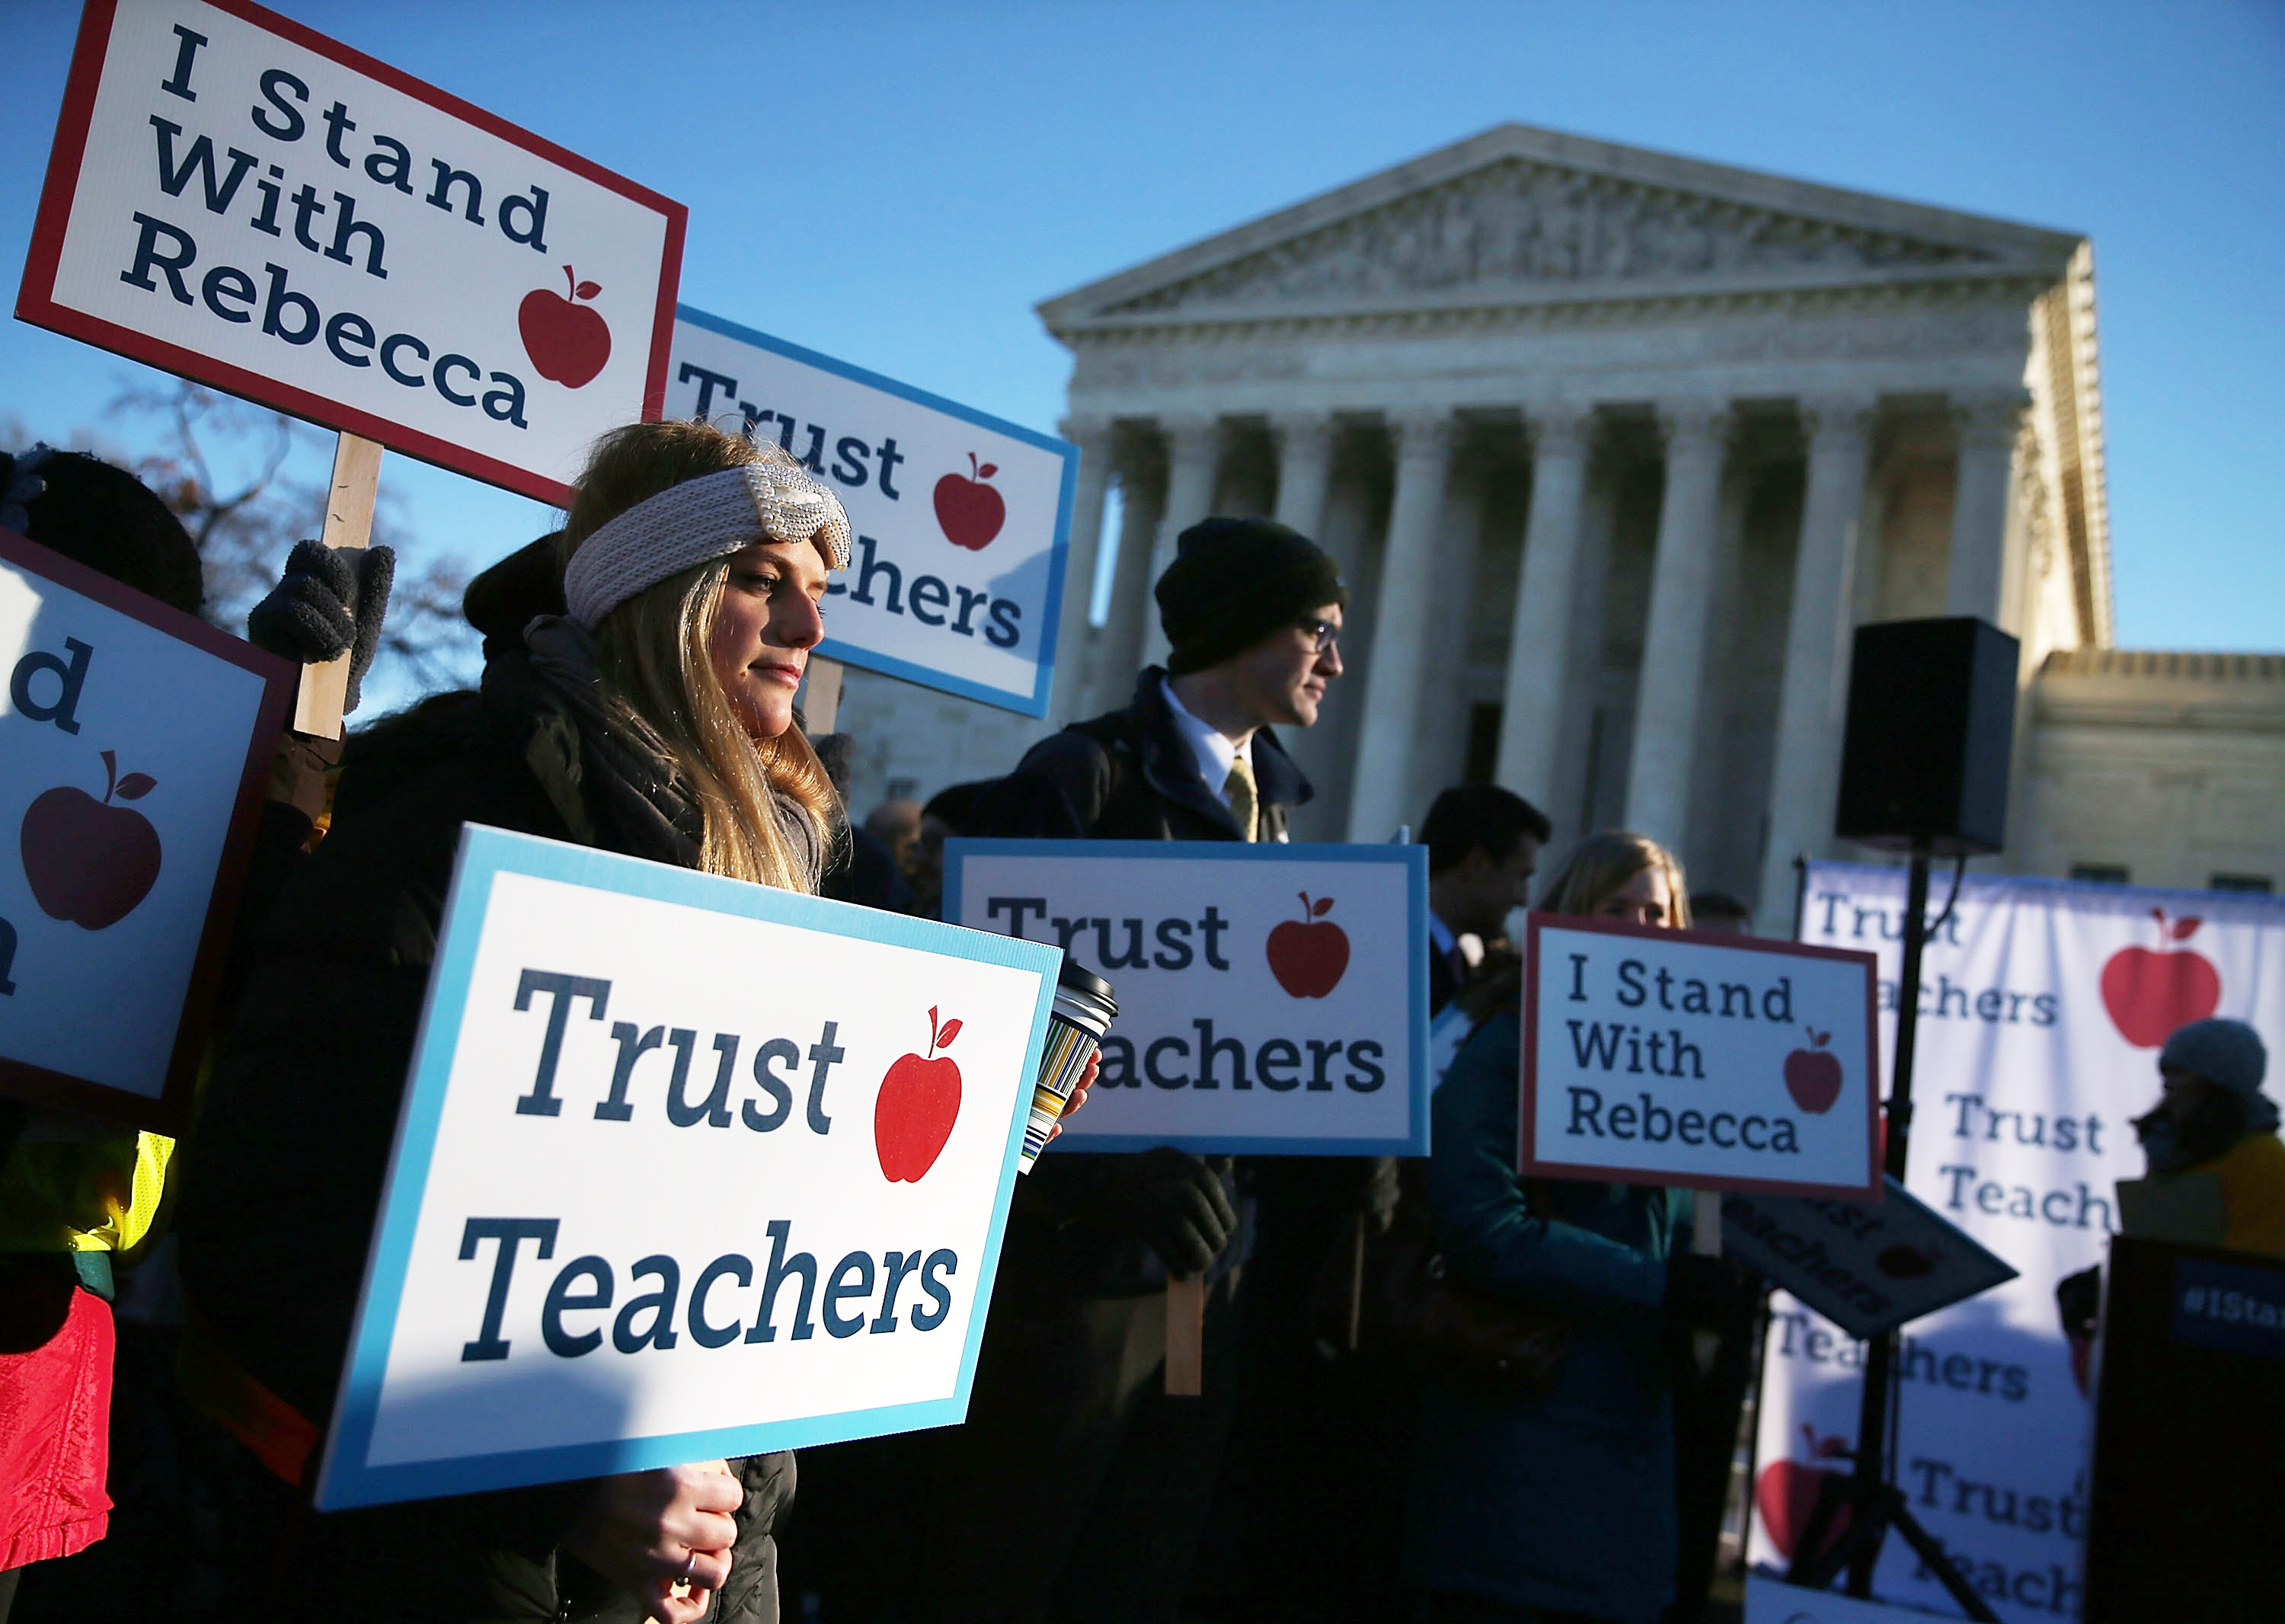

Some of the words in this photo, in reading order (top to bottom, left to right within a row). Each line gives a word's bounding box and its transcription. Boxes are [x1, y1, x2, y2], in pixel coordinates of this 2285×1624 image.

[161, 24, 208, 102] I
[252, 69, 549, 254] Stand
[149, 114, 388, 280] With
[120, 212, 528, 430] Rebecca
[987, 897, 1229, 971] Trust
[1817, 890, 1961, 946] Trut
[1568, 953, 1588, 1002] I
[1616, 959, 1794, 1024] Stand
[513, 967, 845, 1135] Trust
[1097, 1018, 1385, 1093] achers
[1567, 1020, 1705, 1079] With
[1567, 1086, 1800, 1154] Rebecca
[1945, 1092, 2105, 1155] Trust
[1939, 1164, 2114, 1234] Teach
[458, 1216, 958, 1363] Teachers
[1771, 1310, 2029, 1401] Teahers
